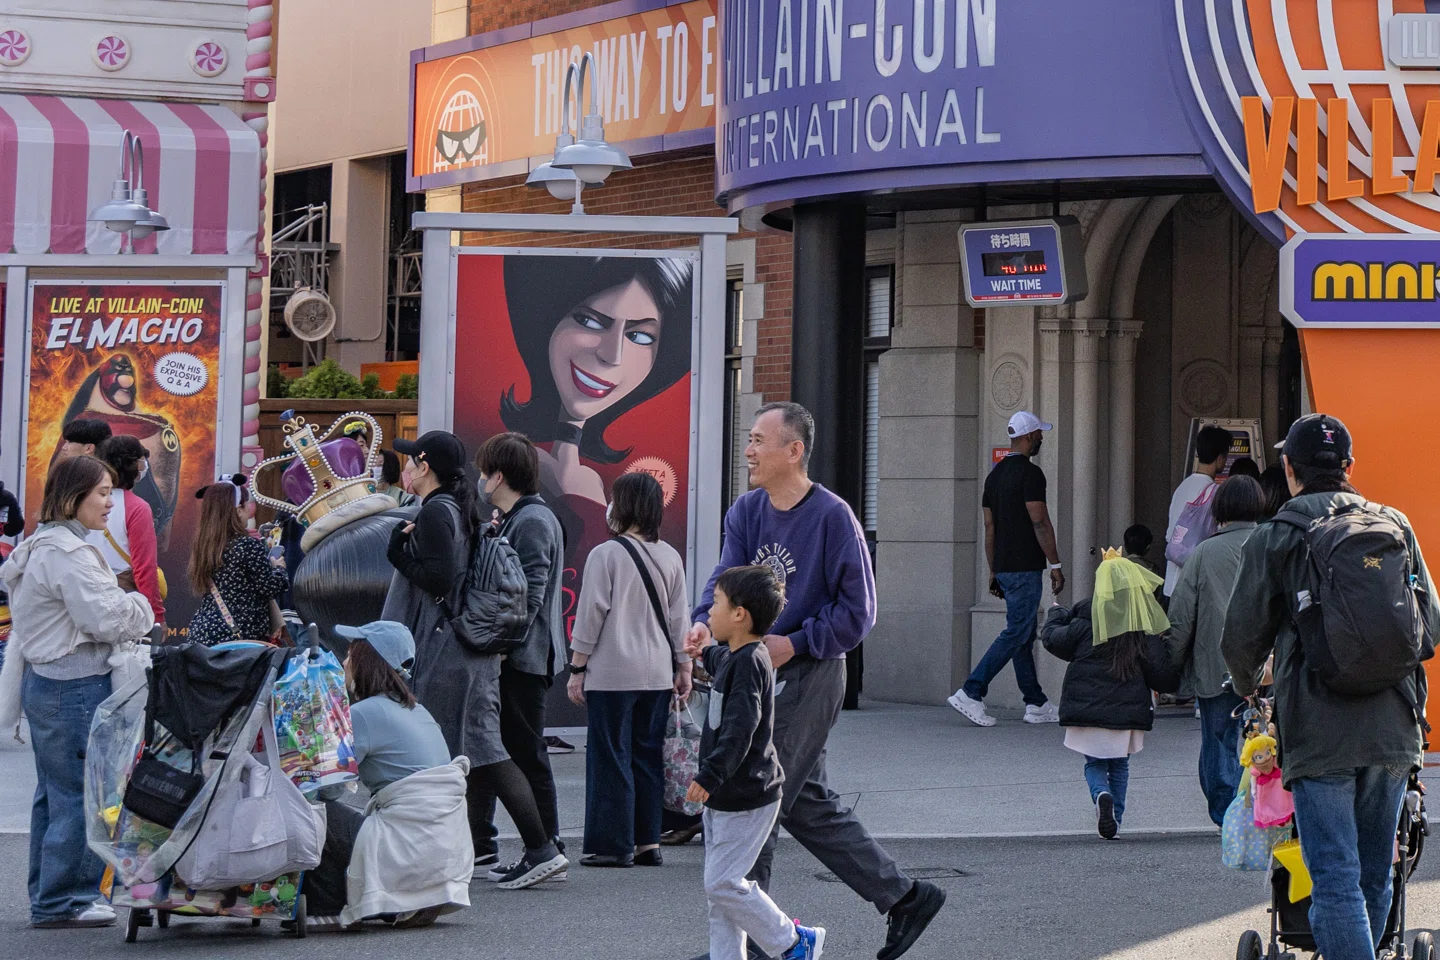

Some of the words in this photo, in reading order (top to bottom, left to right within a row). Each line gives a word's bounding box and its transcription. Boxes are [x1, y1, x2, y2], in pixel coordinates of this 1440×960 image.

[593, 30, 647, 125] WAY
[656, 21, 689, 115] TO
[722, 86, 1002, 176] INTERNATIONAL
[990, 232, 1031, 249] 待ち時間
[990, 280, 1016, 292] WAIT
[1017, 278, 1042, 291] TIME
[50, 297, 83, 314] LIVE
[85, 297, 105, 314] AT
[108, 297, 204, 315] VILLAIN-CON!
[45, 316, 83, 350] EL
[85, 316, 204, 351] MACHO
[160, 366, 203, 383] EXPLOSIVE
[165, 359, 186, 371] JOIN
[187, 364, 201, 375] HIS
[166, 376, 174, 385] Q
[183, 381, 191, 389] A
